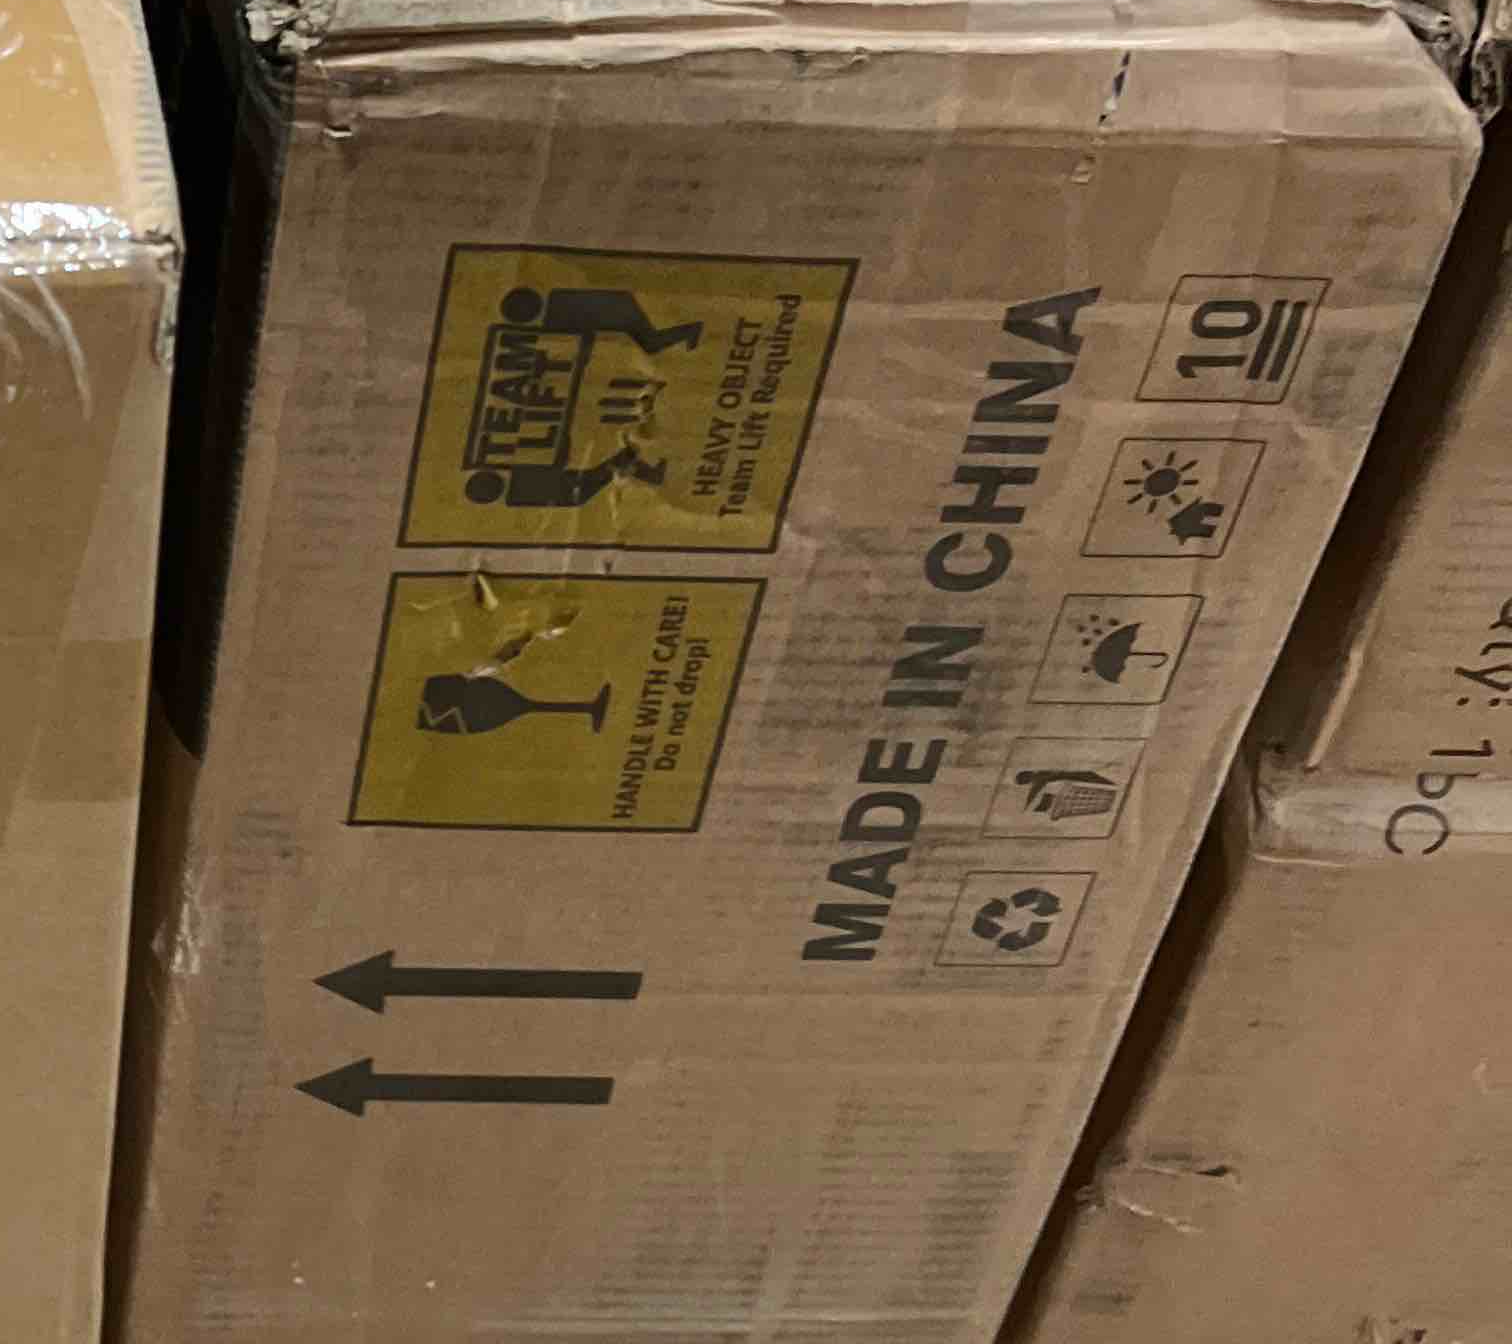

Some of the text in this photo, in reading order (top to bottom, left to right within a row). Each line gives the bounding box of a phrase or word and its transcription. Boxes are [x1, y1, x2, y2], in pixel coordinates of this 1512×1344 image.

[480, 333, 540, 458] TEAM
[692, 317, 762, 496] HEAVY OBJECT
[718, 294, 802, 517] Team Lift Required
[800, 286, 1102, 962] MADE IN CHINA
[611, 735, 654, 819] HANDLE
[636, 669, 670, 727] WITH
[654, 743, 681, 771] Do
[668, 701, 693, 736] not
